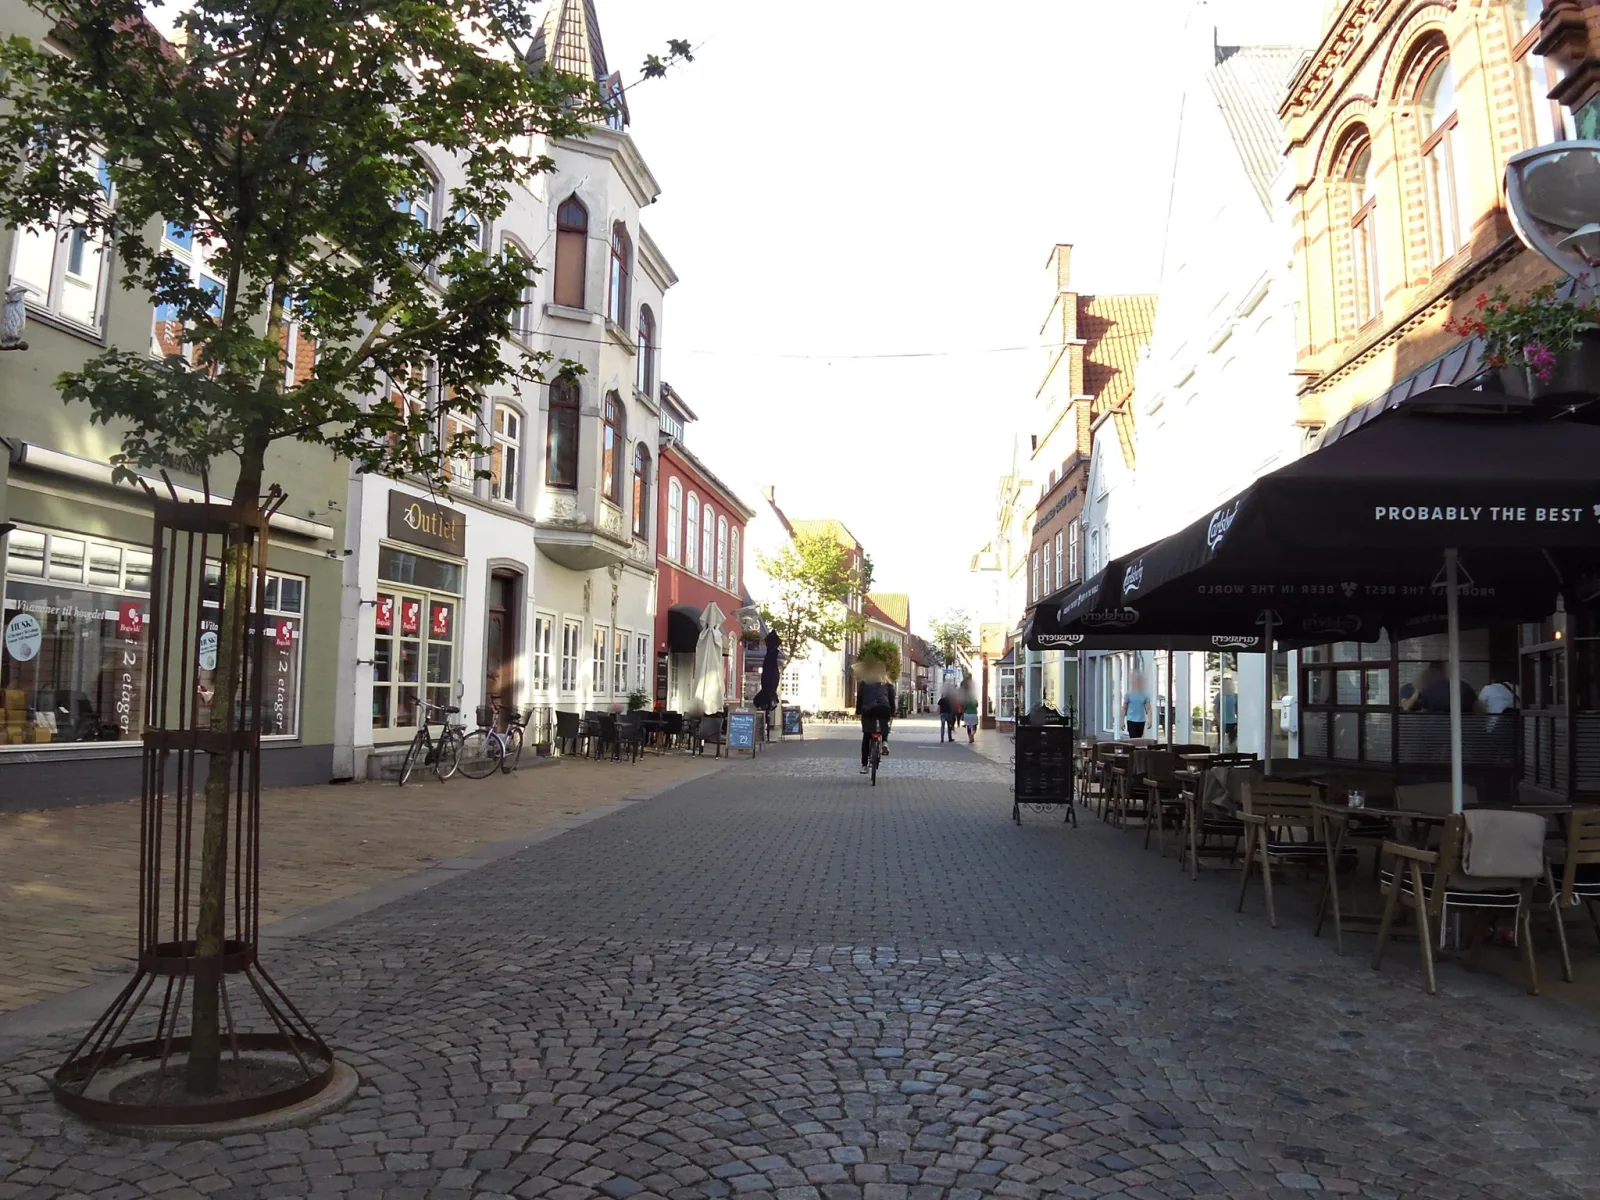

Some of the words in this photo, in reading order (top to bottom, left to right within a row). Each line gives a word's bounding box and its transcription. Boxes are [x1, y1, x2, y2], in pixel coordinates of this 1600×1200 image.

[410, 503, 456, 541] Outlet
[1375, 506, 1482, 521] PROBABLY
[1490, 507, 1526, 521] THE
[1535, 508, 1583, 522] BEST
[62, 605, 72, 616] til
[73, 606, 106, 620] hovedet
[122, 651, 136, 665] 2
[278, 661, 288, 672] 2
[116, 673, 133, 735] etager
[273, 678, 286, 729] etager
